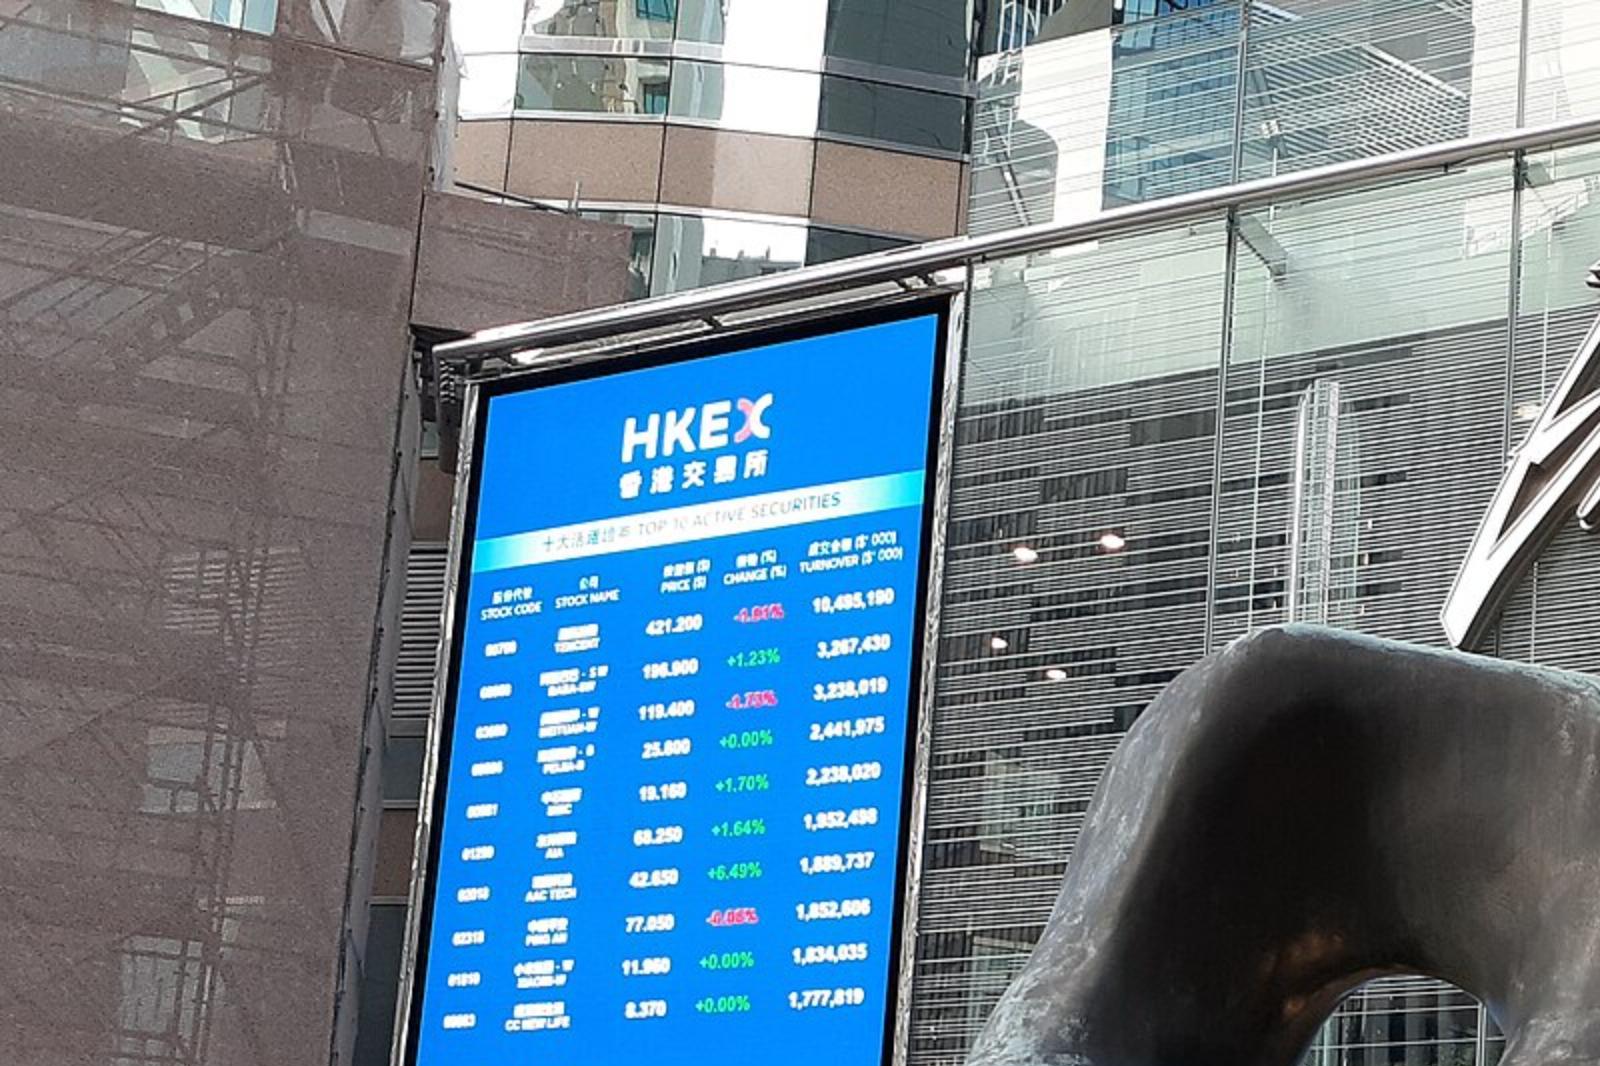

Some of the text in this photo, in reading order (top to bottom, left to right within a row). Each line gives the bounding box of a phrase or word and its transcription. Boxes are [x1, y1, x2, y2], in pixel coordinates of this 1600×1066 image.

[621, 393, 774, 464] HKEX
[751, 492, 842, 519] SECURITIES
[799, 553, 859, 574] TURNOVER
[723, 567, 768, 585] CHANGE
[555, 593, 588, 609] STOCK
[728, 649, 779, 666] +1.23%
[720, 731, 773, 747] +0.00%
[716, 775, 768, 791] +1.70%
[712, 820, 765, 836] +1.64%
[709, 863, 761, 880] +6.49%
[700, 952, 753, 969] +0.00%
[696, 996, 751, 1013] +0.00%
